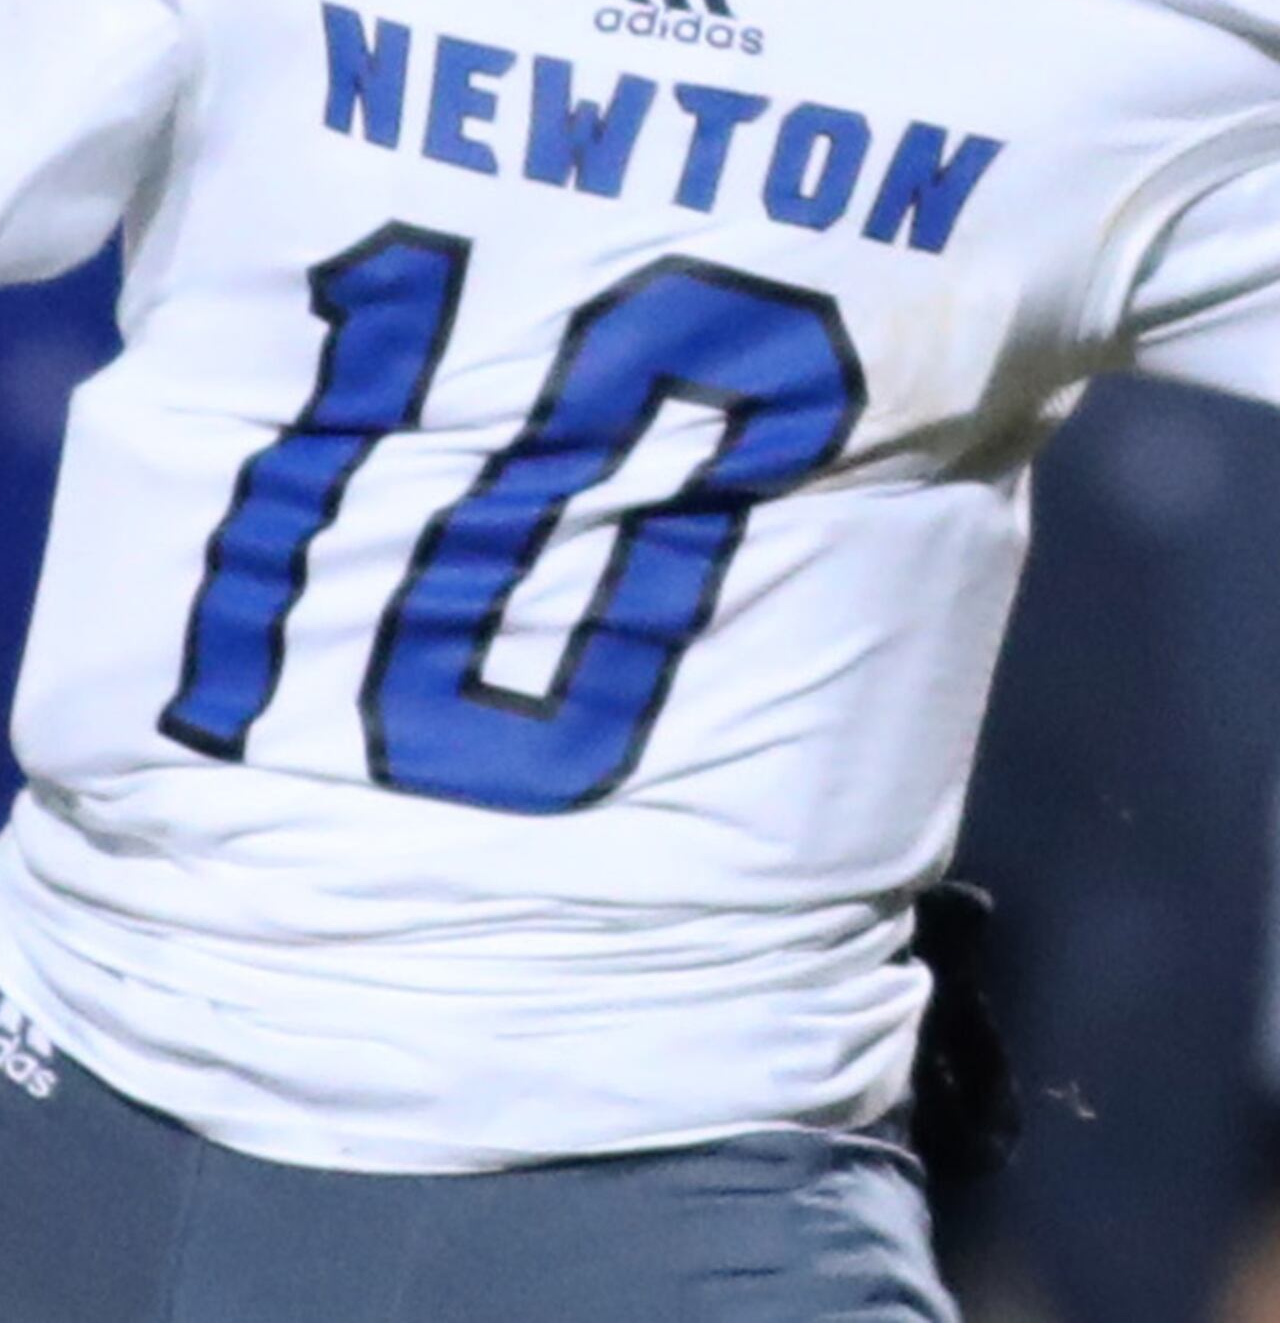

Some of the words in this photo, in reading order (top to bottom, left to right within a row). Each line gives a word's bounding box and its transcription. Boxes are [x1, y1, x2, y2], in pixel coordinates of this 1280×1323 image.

[320, 0, 1007, 255] NEWTON
[593, 5, 765, 57] adidas
[157, 218, 869, 817] 10
